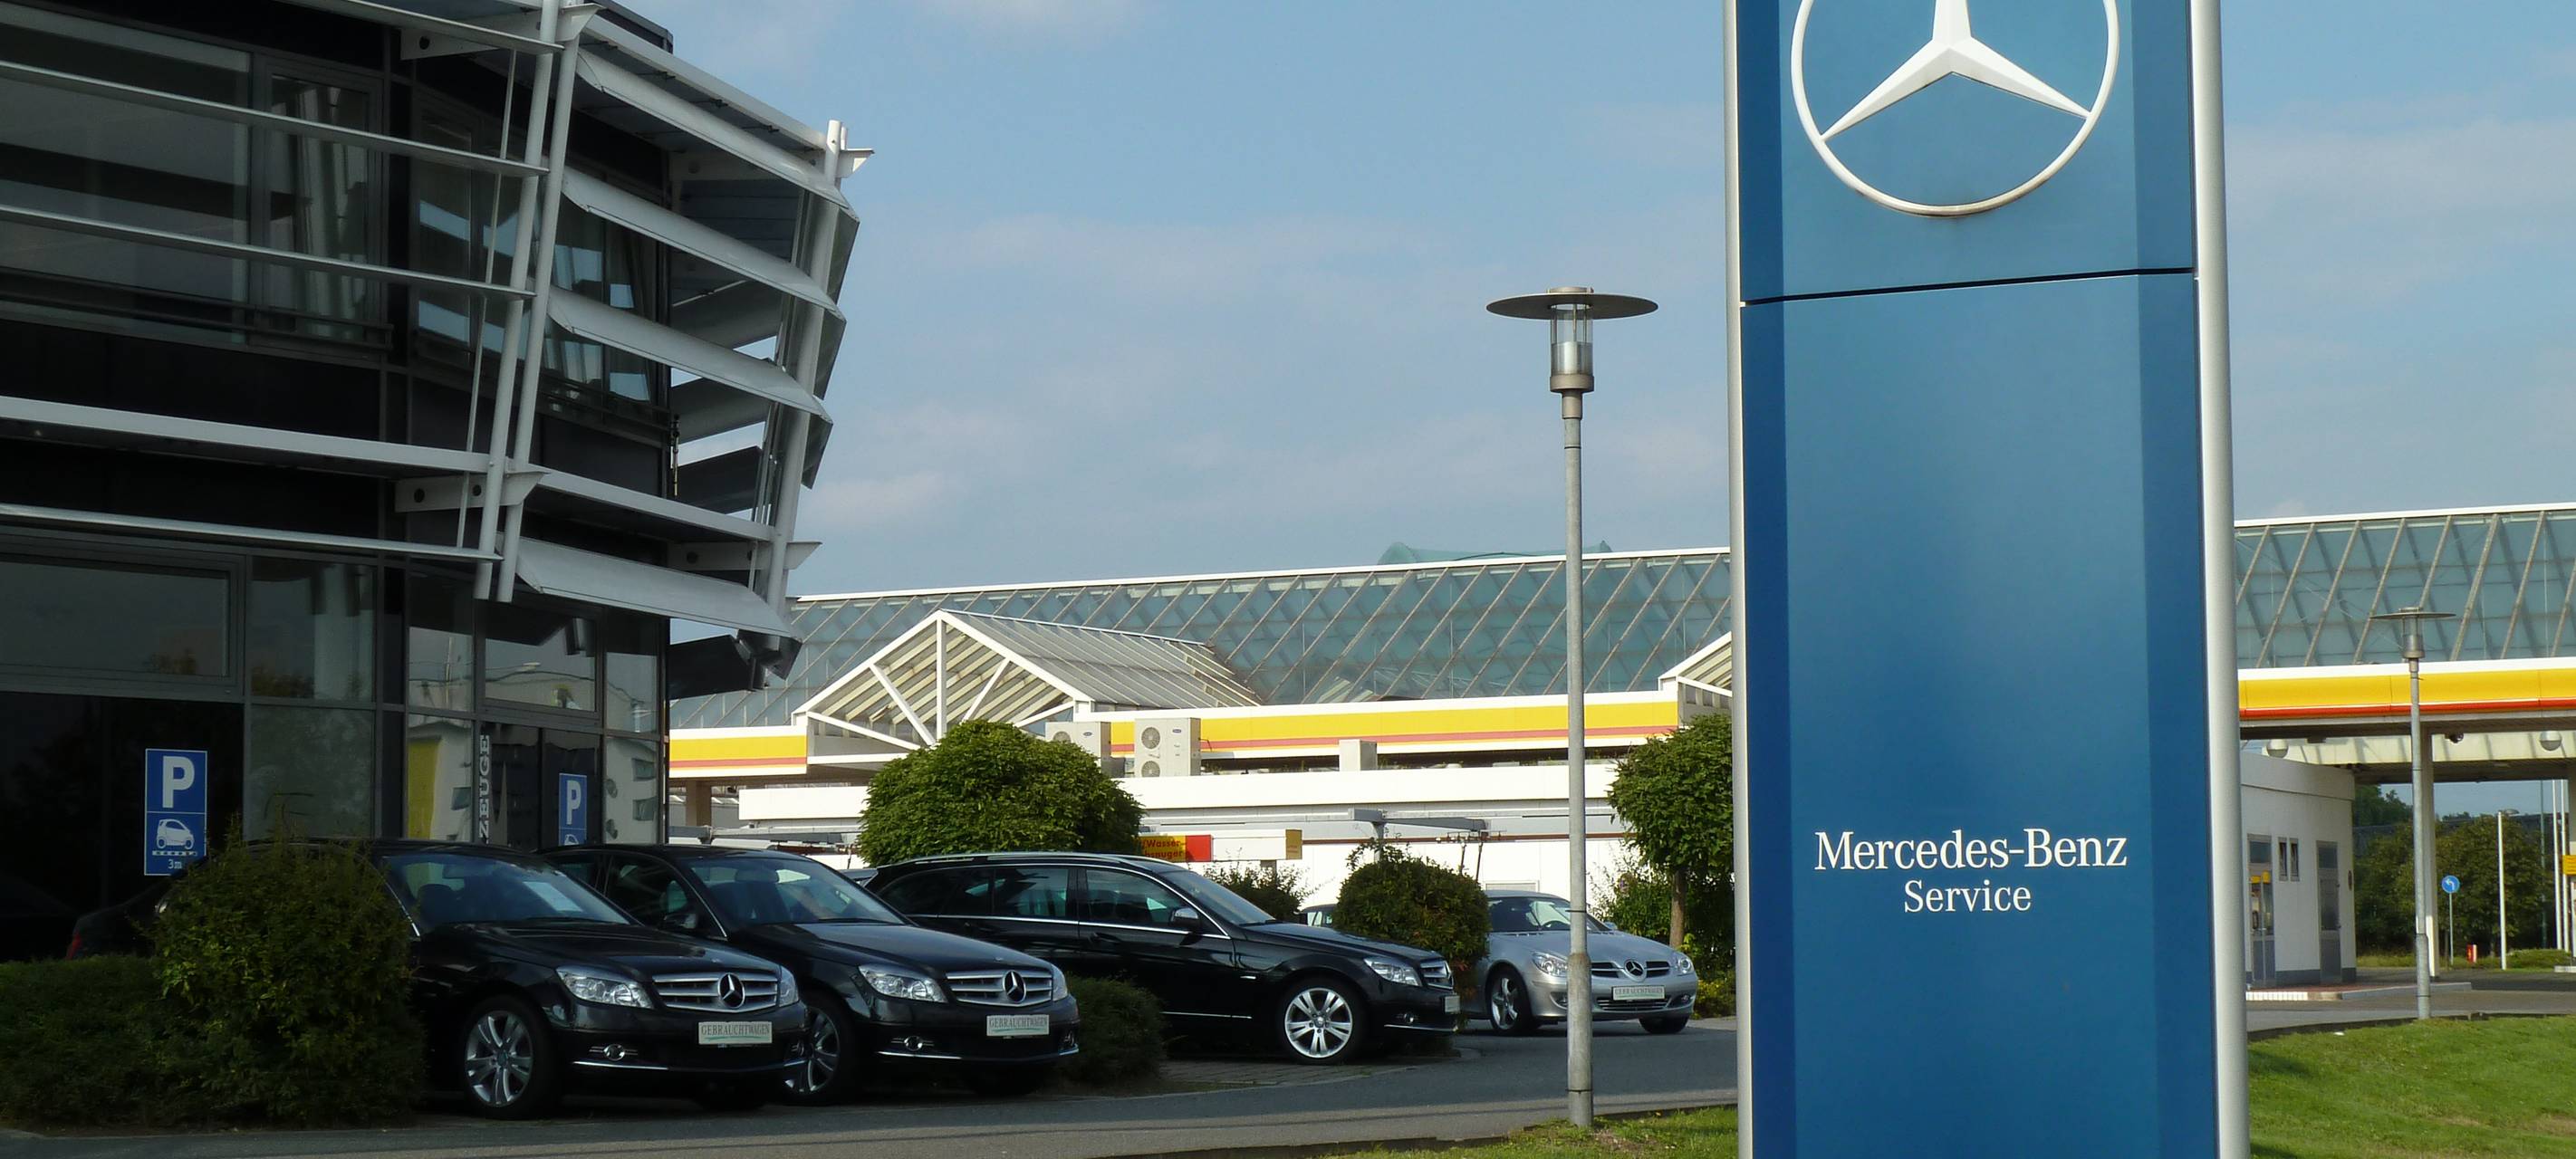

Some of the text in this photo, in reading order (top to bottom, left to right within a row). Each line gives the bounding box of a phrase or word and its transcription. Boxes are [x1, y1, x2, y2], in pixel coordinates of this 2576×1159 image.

[162, 755, 195, 808] P
[479, 735, 490, 844] ZEUGE
[566, 780, 582, 825] P
[1814, 828, 2128, 870] Mercedes-Benz
[1904, 879, 2032, 913] Service
[701, 1023, 770, 1036] GEBRAUCHTWAGEN
